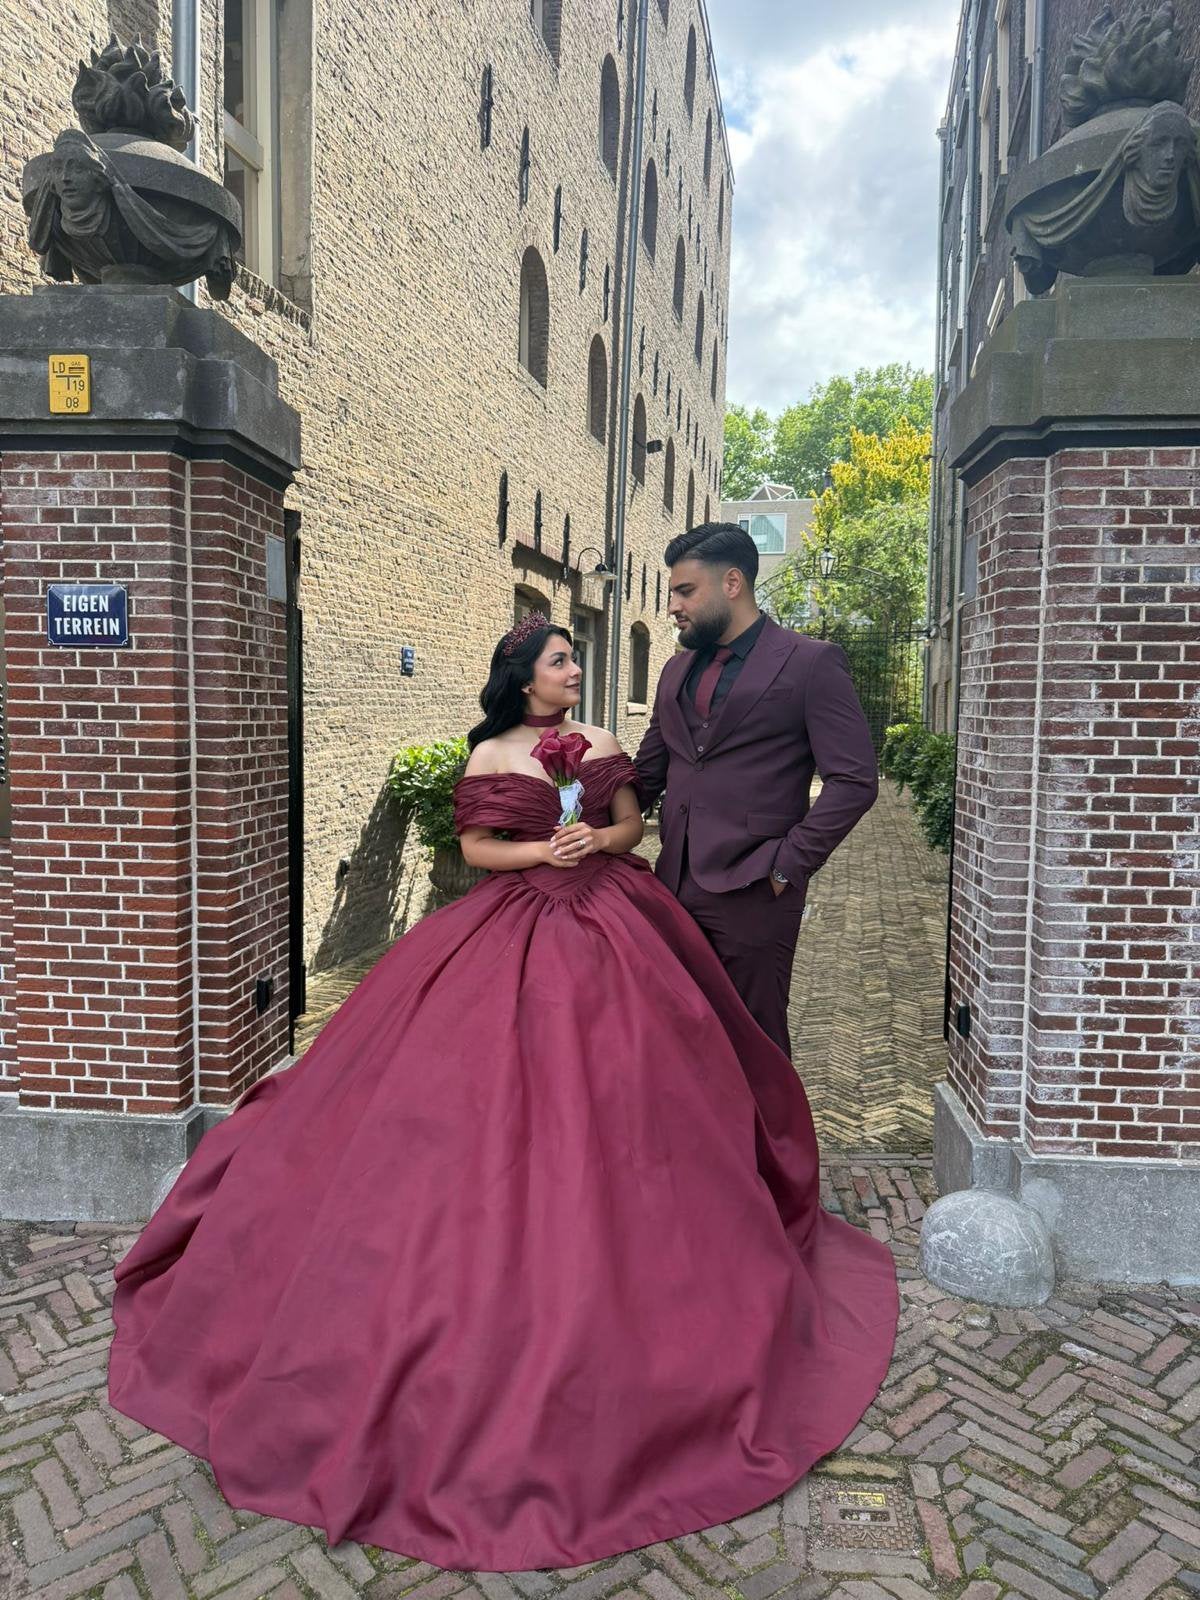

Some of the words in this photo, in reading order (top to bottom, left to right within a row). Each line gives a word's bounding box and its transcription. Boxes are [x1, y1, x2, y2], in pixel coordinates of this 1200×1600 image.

[52, 362, 66, 374] LD
[65, 397, 79, 408] 08
[63, 594, 109, 612] EIGEN
[54, 617, 120, 636] TERREIN
